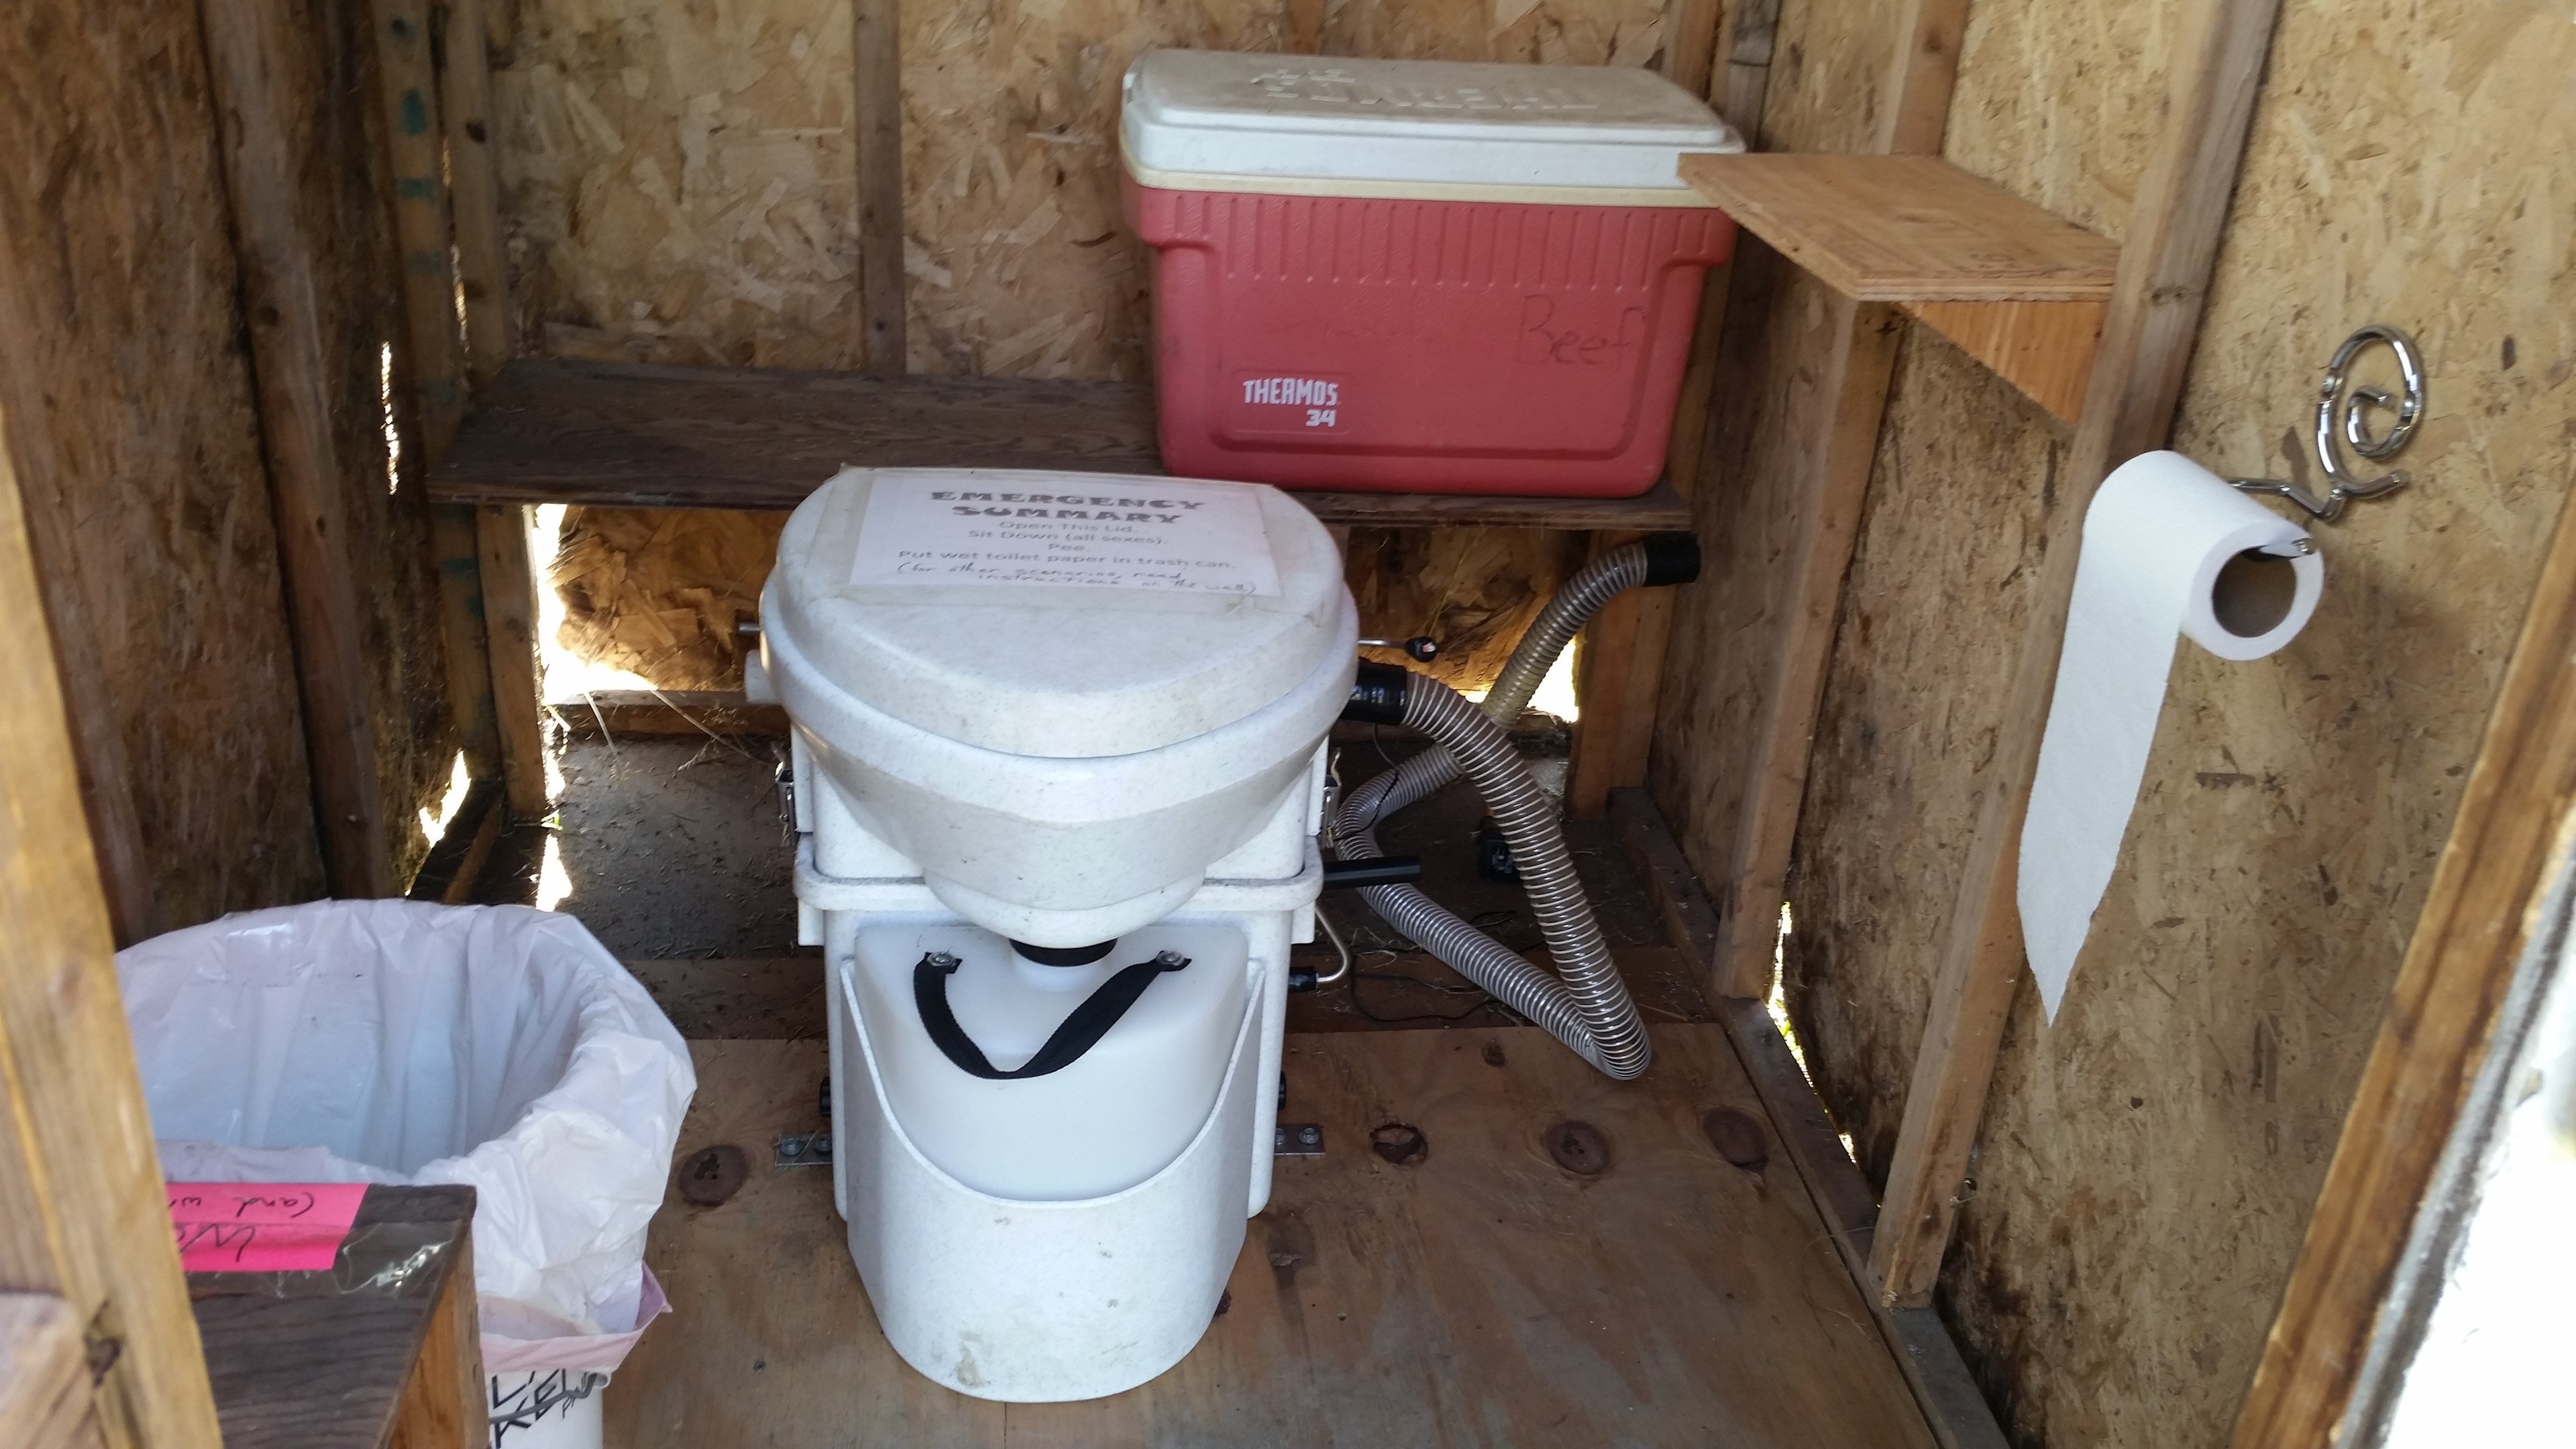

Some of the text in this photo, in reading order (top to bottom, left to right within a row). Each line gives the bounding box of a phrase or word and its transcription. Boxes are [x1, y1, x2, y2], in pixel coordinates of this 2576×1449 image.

[1516, 292, 1646, 371] Beef
[1242, 378, 1339, 406] THERMOS
[1305, 409, 1336, 427] 34
[932, 492, 1203, 510] EMERGENCY
[952, 506, 1181, 523] SUMMARY
[999, 521, 1138, 533] Open This Lid.
[969, 530, 1169, 545] Sit Down (all sexes).
[1049, 543, 1090, 552] Pee.
[941, 551, 979, 559] wet
[986, 552, 1040, 561] toilet
[1047, 555, 1106, 564] paper
[1113, 556, 1130, 564] in
[1138, 557, 1189, 566] trash
[1195, 560, 1235, 569] can.
[949, 561, 1000, 573] other
[978, 574, 1120, 586] instructions
[232, 1191, 315, 1219] (and
